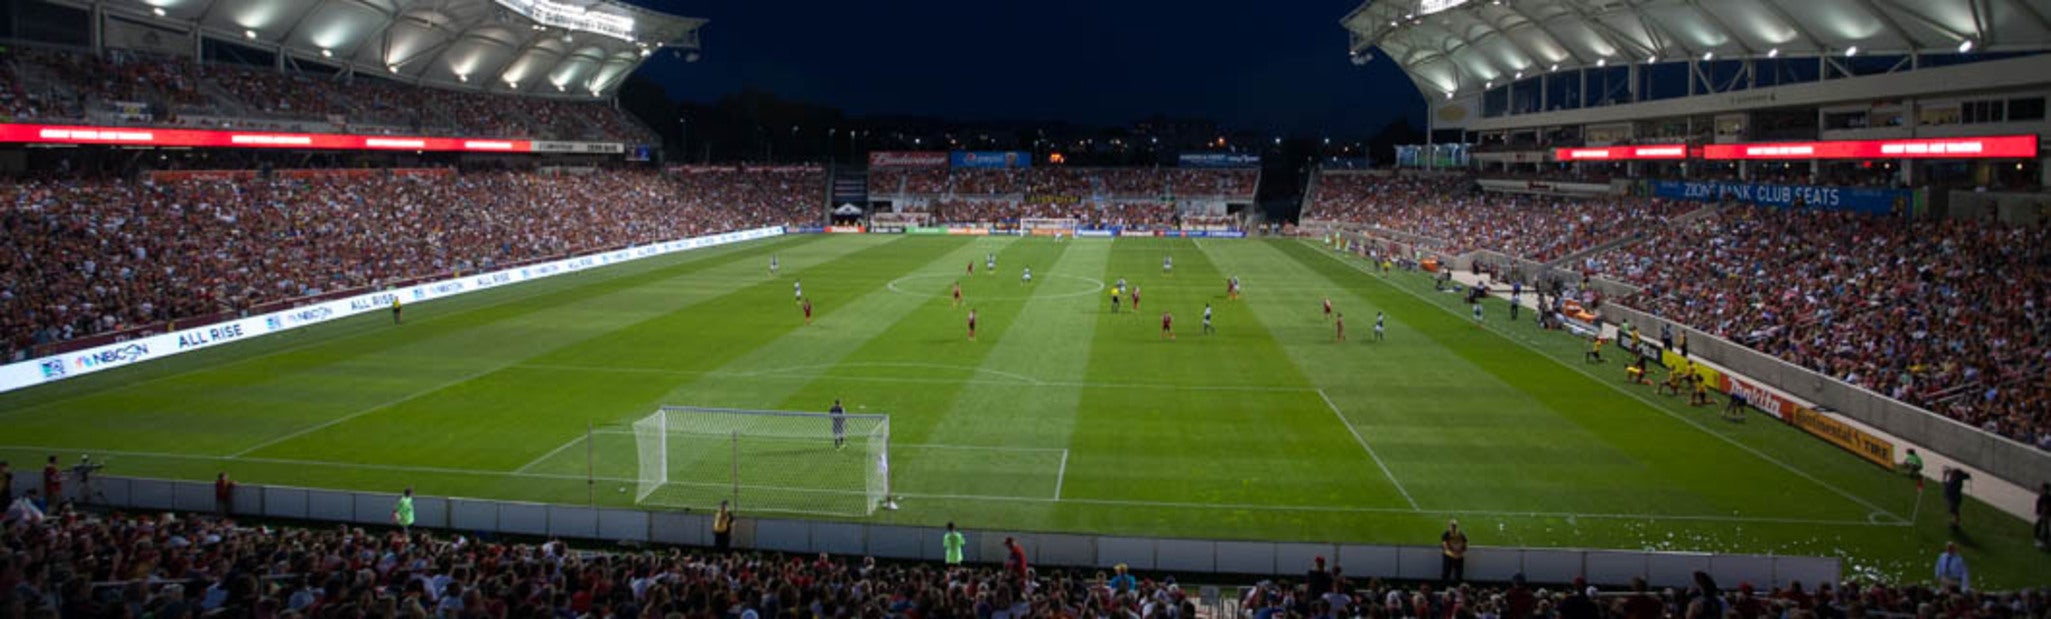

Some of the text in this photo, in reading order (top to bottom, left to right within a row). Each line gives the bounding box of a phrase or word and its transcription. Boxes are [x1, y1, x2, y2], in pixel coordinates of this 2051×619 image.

[1757, 185, 1791, 202] CLUB
[1795, 186, 1839, 206] SEATS
[178, 332, 208, 349] ALL
[210, 323, 244, 341] RISE
